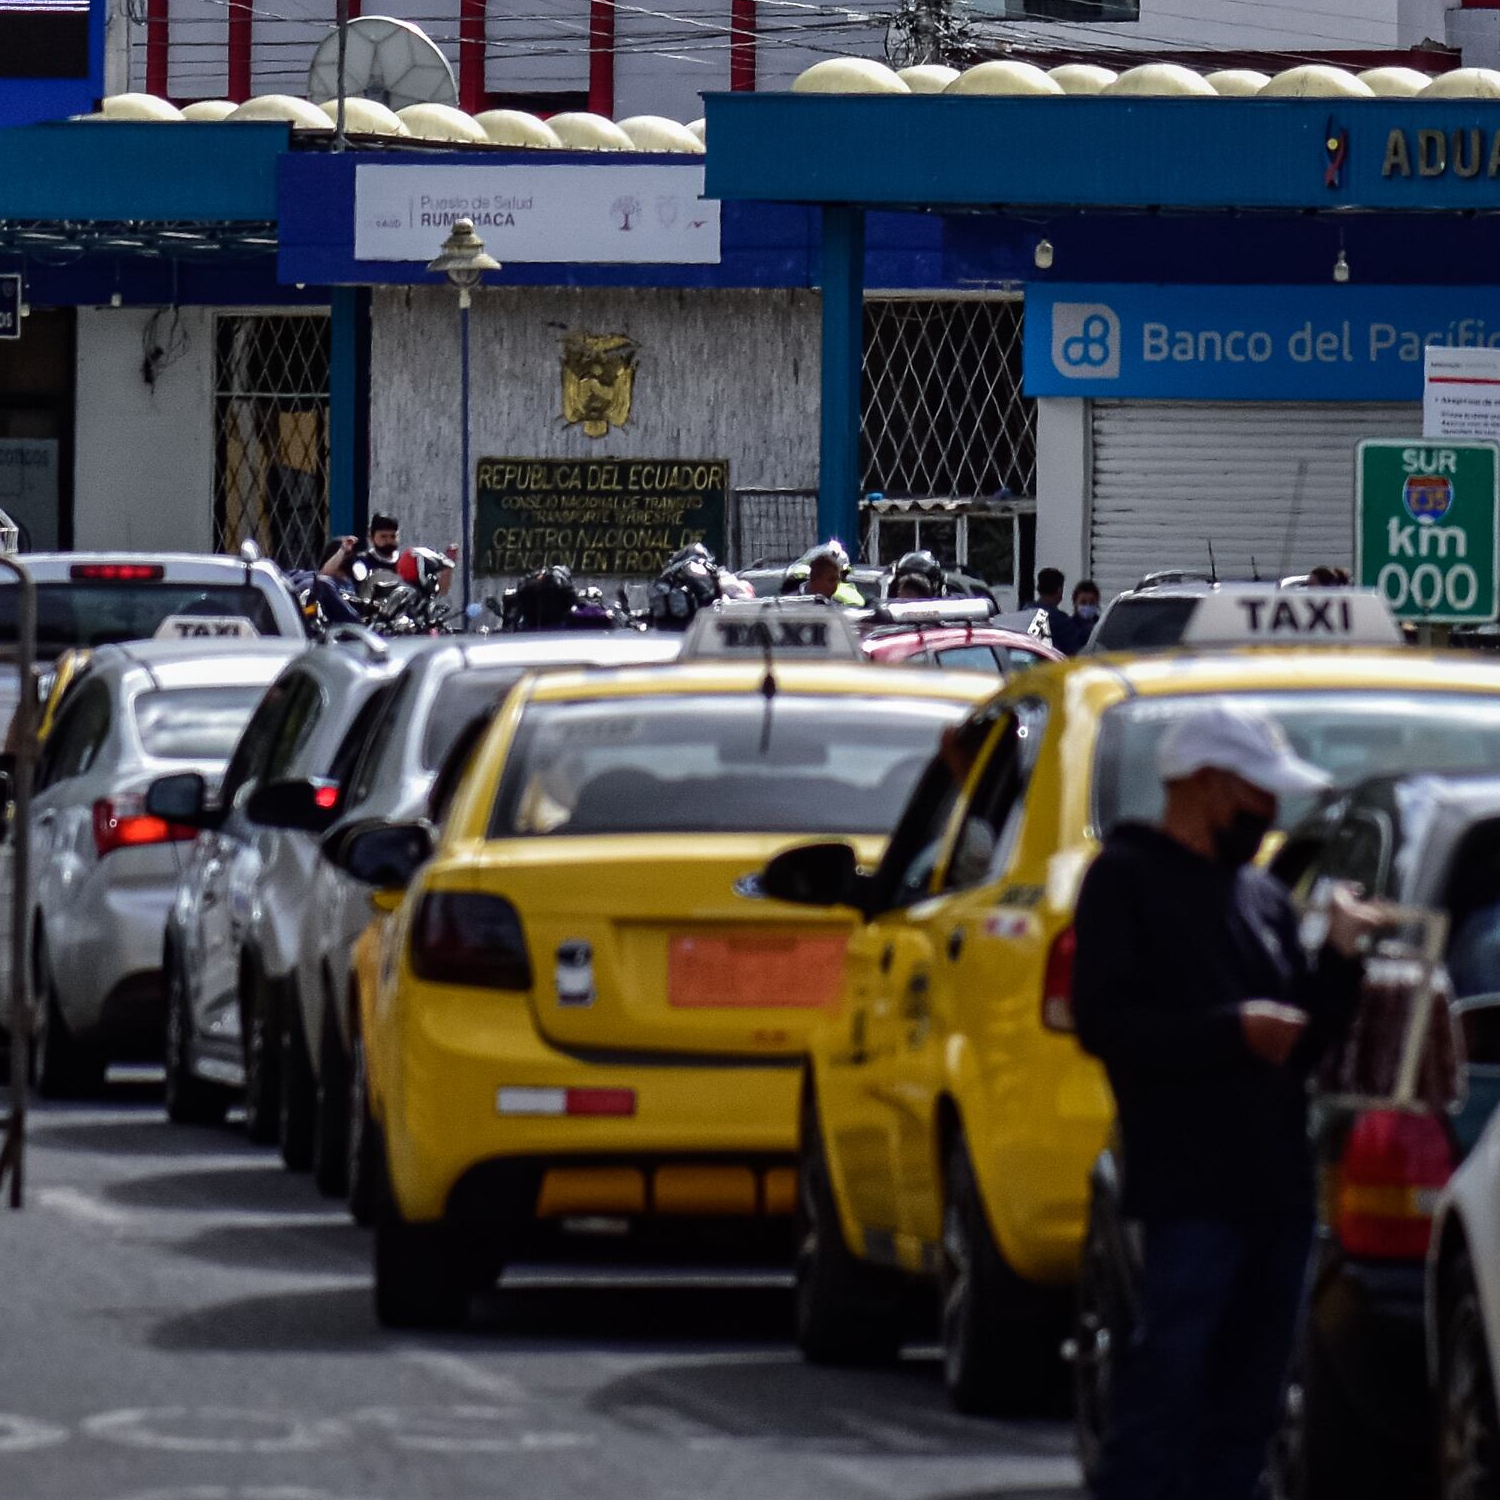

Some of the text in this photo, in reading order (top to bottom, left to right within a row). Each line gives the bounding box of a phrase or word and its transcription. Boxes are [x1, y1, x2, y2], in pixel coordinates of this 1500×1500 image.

[472, 195, 491, 211] de
[493, 195, 534, 211] Salud
[1142, 321, 1274, 363] Banco
[1288, 320, 1354, 363] del
[1402, 448, 1457, 473] SUR
[478, 465, 723, 492] REPUBLCA DEL ECUADOR
[492, 527, 573, 550] CENTRO
[576, 527, 672, 550] NACIONAL
[1387, 515, 1468, 557] km
[581, 550, 608, 572] EN
[614, 550, 678, 572] FRON
[1377, 562, 1479, 611] 000
[1238, 596, 1352, 634] TAXI
[172, 622, 241, 639] TAXI
[715, 622, 829, 649] TAXI
